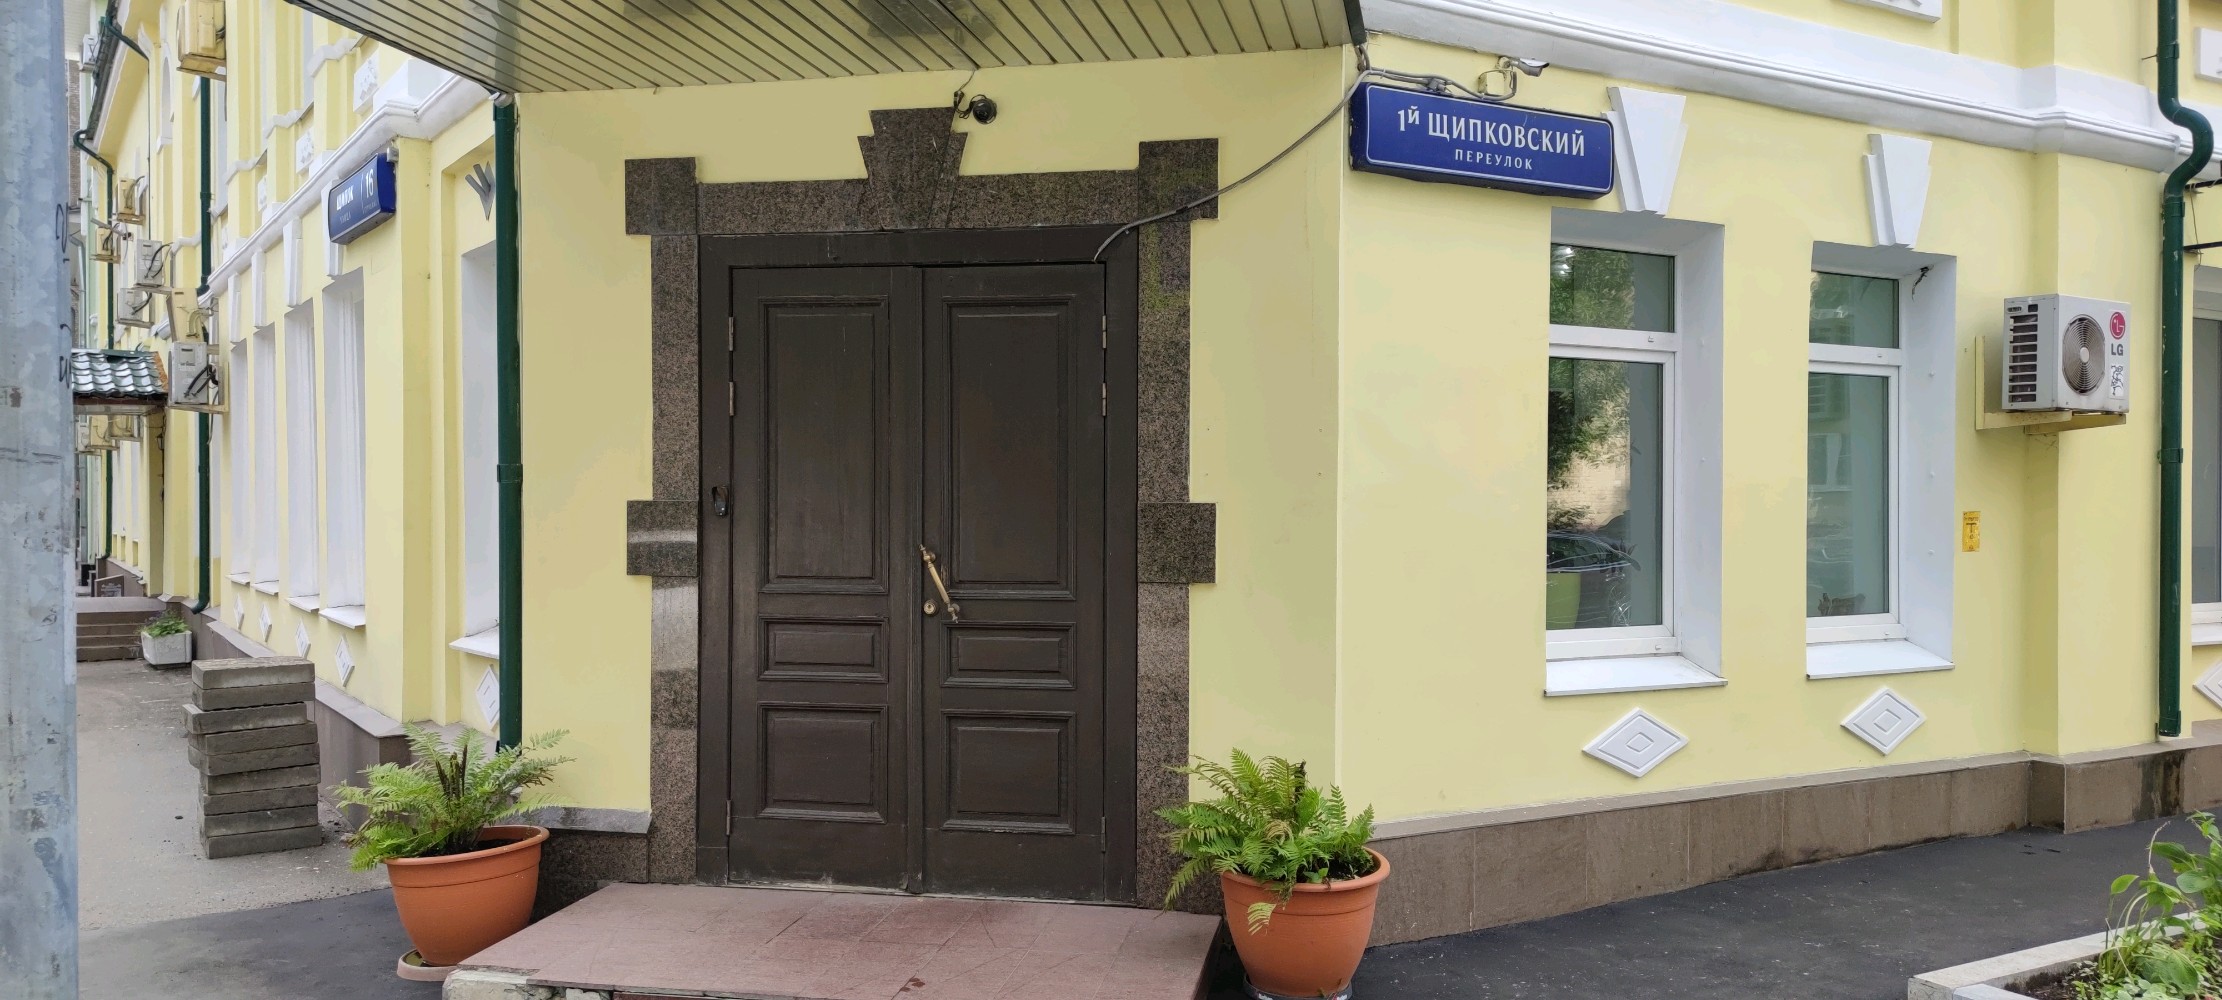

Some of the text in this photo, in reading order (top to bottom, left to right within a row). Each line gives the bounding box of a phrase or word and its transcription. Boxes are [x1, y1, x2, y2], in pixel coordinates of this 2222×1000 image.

[1427, 112, 1586, 158] ЩИПКОВСКИЙ
[1454, 148, 1533, 171] ПЕРЕУЛОК
[365, 168, 374, 198] 16
[2110, 342, 2124, 357] LG
